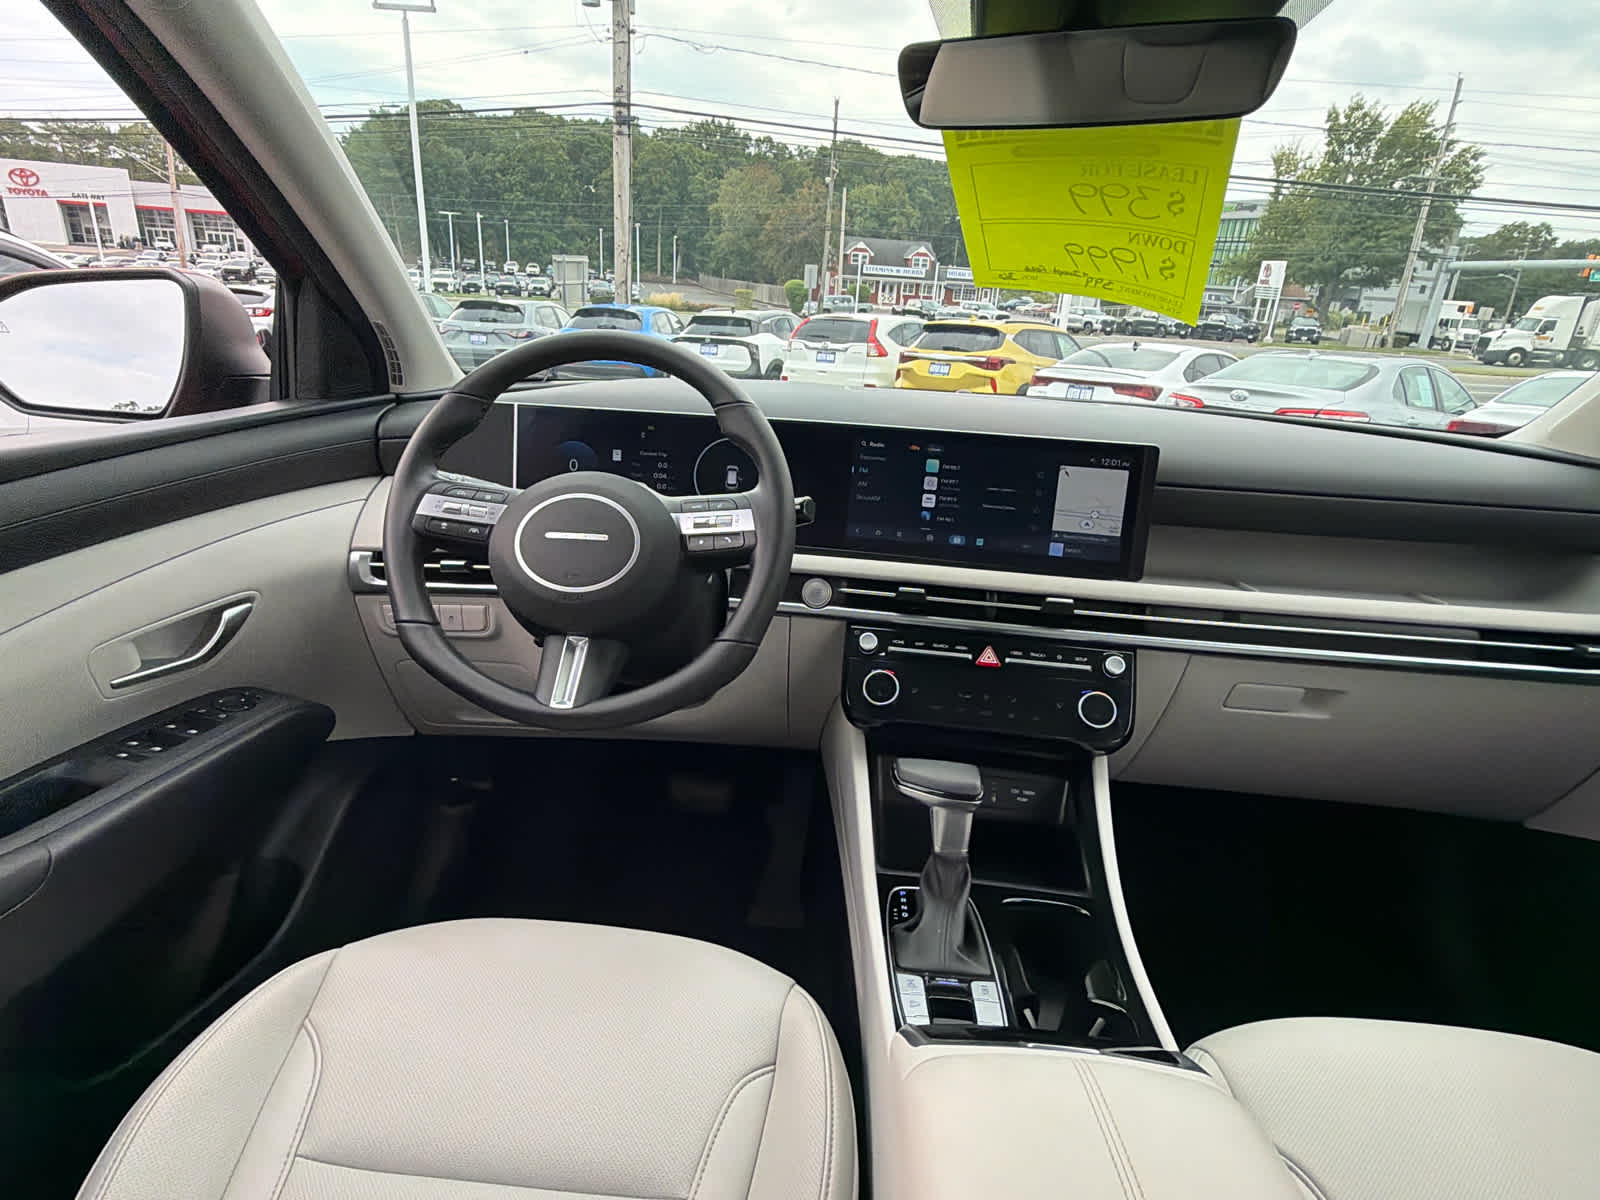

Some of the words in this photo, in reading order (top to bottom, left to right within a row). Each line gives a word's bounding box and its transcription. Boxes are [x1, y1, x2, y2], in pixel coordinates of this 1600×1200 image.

[7, 187, 48, 197] TOYOTA
[569, 459, 578, 472] 0
[1101, 457, 1121, 466] 12:01
